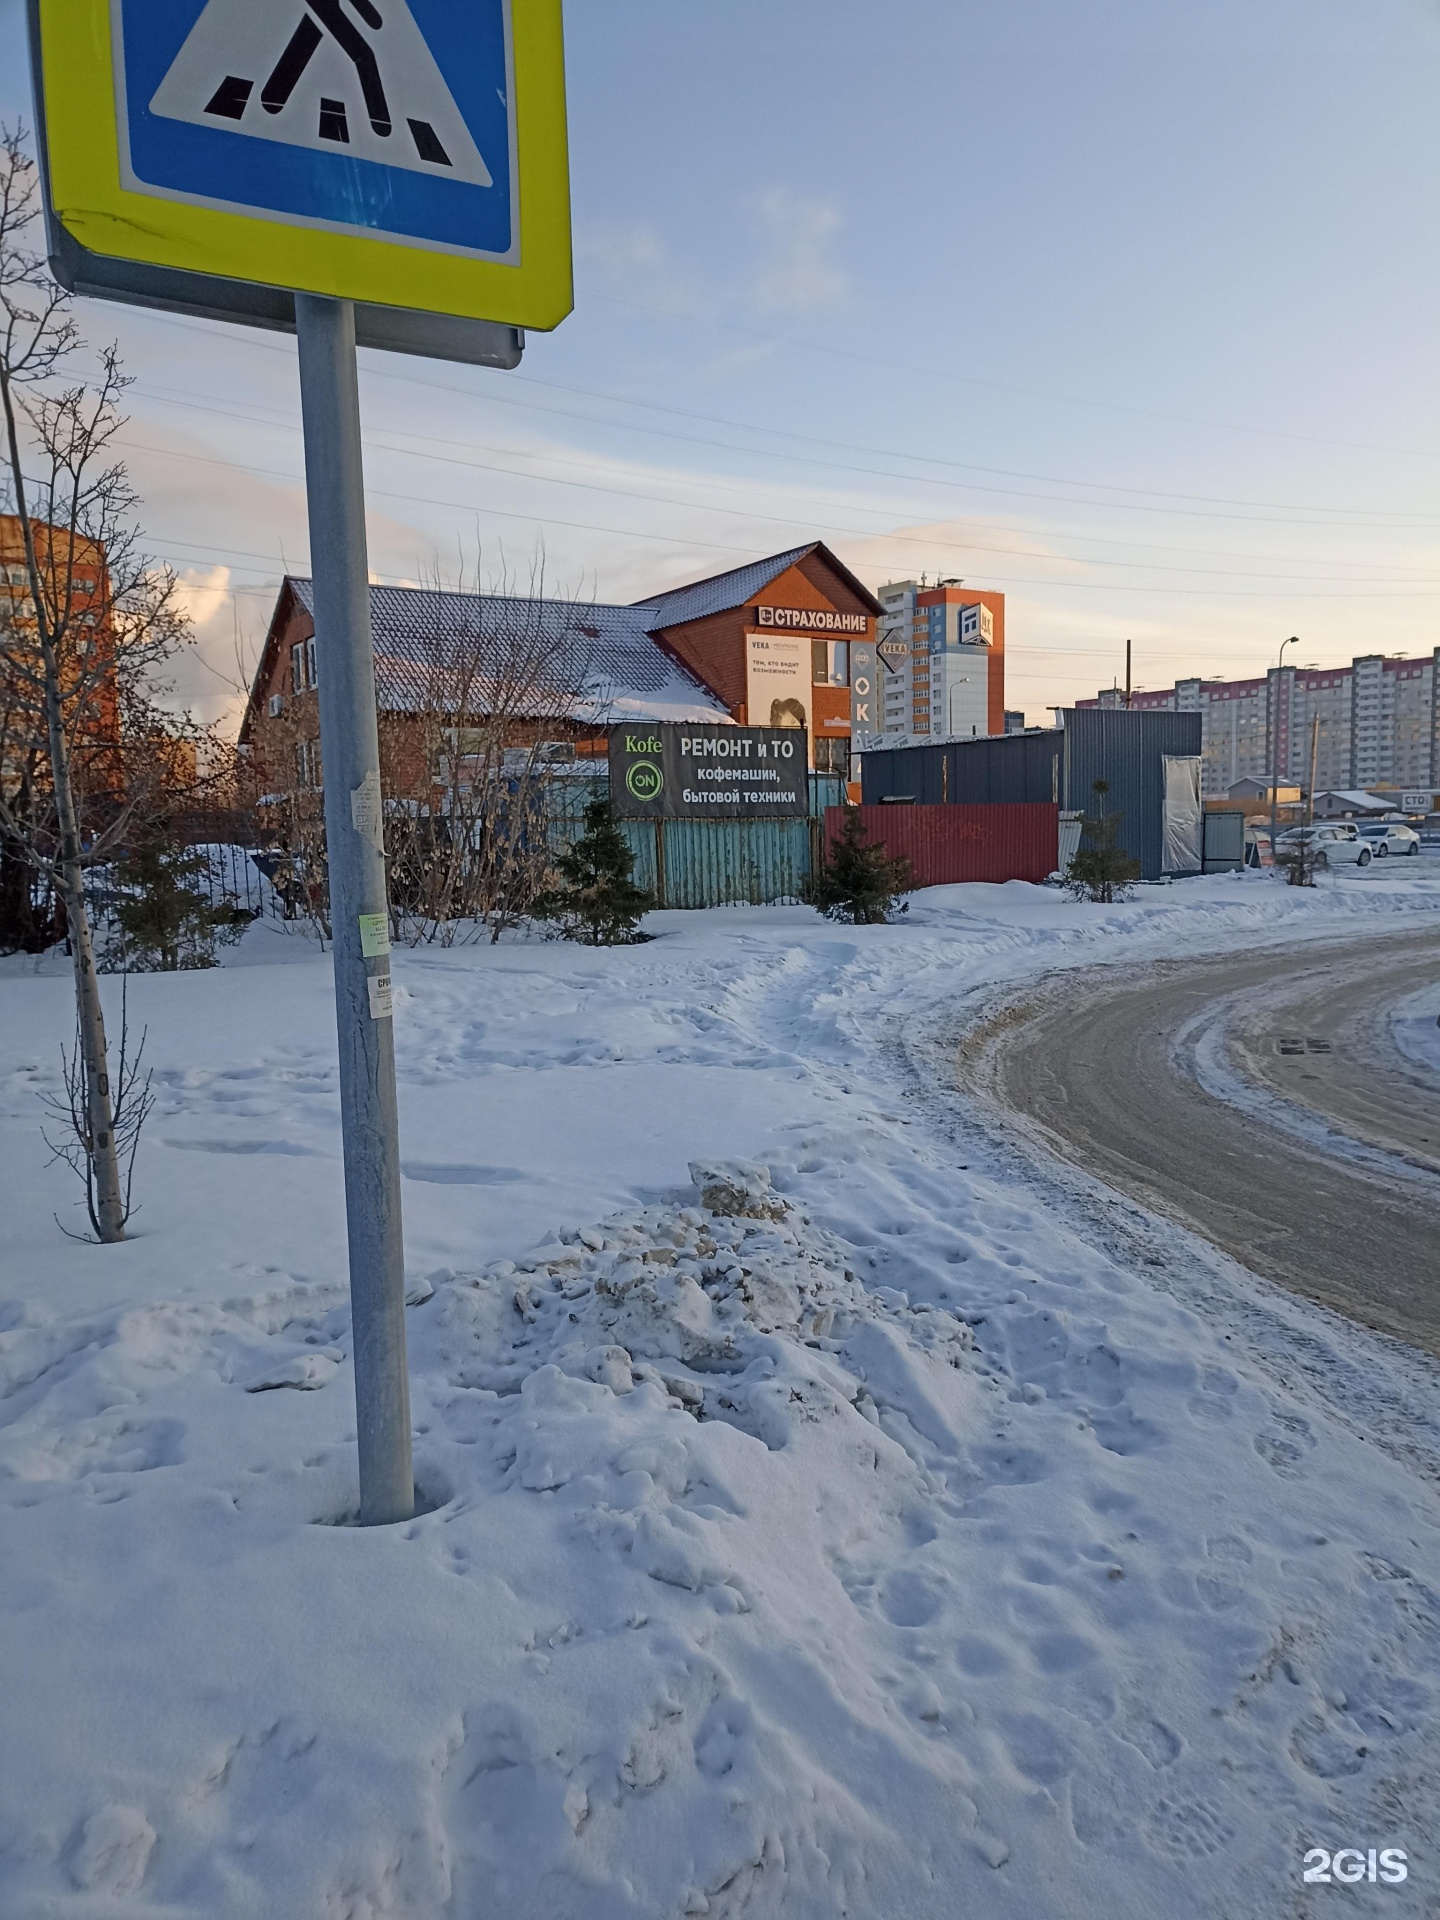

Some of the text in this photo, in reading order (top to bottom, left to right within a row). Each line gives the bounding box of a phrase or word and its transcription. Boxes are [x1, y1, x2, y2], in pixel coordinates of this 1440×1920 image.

[774, 608, 867, 632] СТРАХОВАНИЕ
[751, 641, 770, 650] VEKA
[883, 643, 906, 655] VEKA
[625, 735, 663, 753] Kofe
[681, 737, 794, 758] РЕМОНТ и ТО
[634, 774, 655, 787] ON
[697, 766, 781, 783] кофемашин,
[682, 788, 796, 803] бытовой техники
[1405, 795, 1425, 805] СТО
